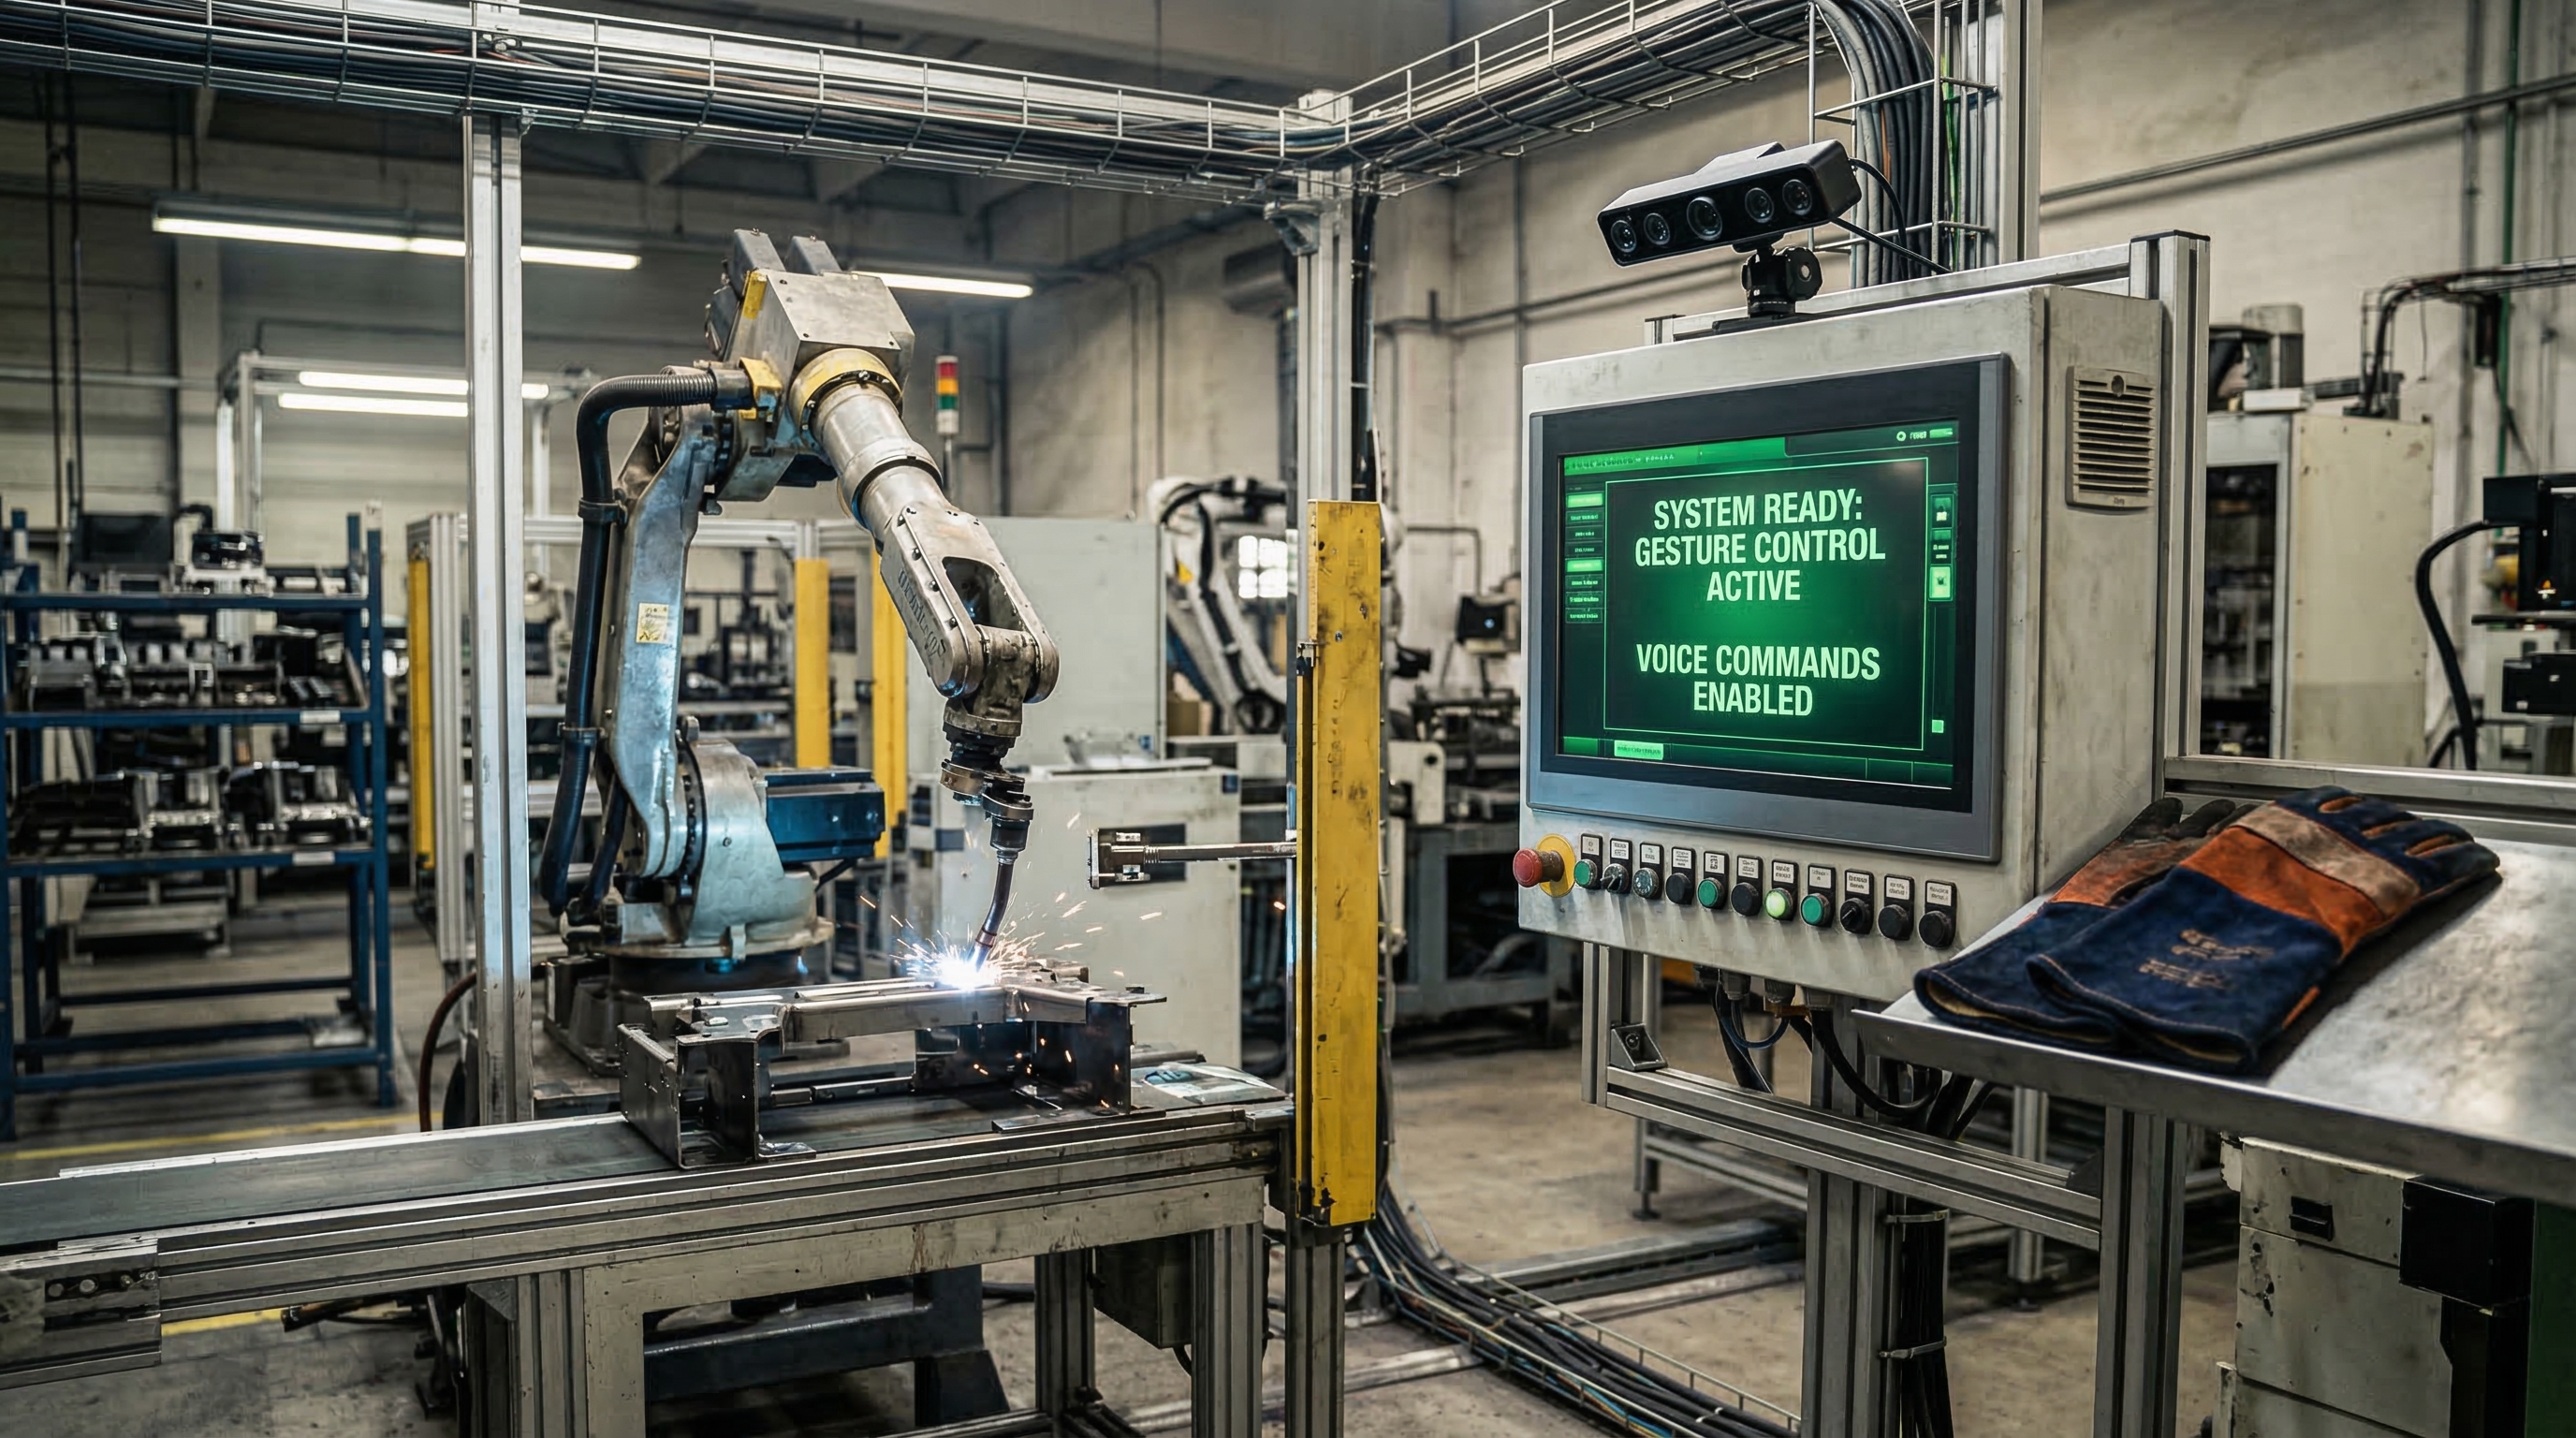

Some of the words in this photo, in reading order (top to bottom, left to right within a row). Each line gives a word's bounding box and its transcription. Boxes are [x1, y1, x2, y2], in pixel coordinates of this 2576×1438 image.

[1654, 495, 1755, 530] SYSTEM
[1764, 488, 1863, 525] READY:
[1635, 533, 1747, 567] GESTURE
[1754, 527, 1886, 564] CONTROL
[1706, 569, 1801, 602] ACTIVE
[1636, 643, 1708, 674] VOICE
[1716, 644, 1881, 681] COMMANDS
[1693, 681, 1813, 716] ENABLED
